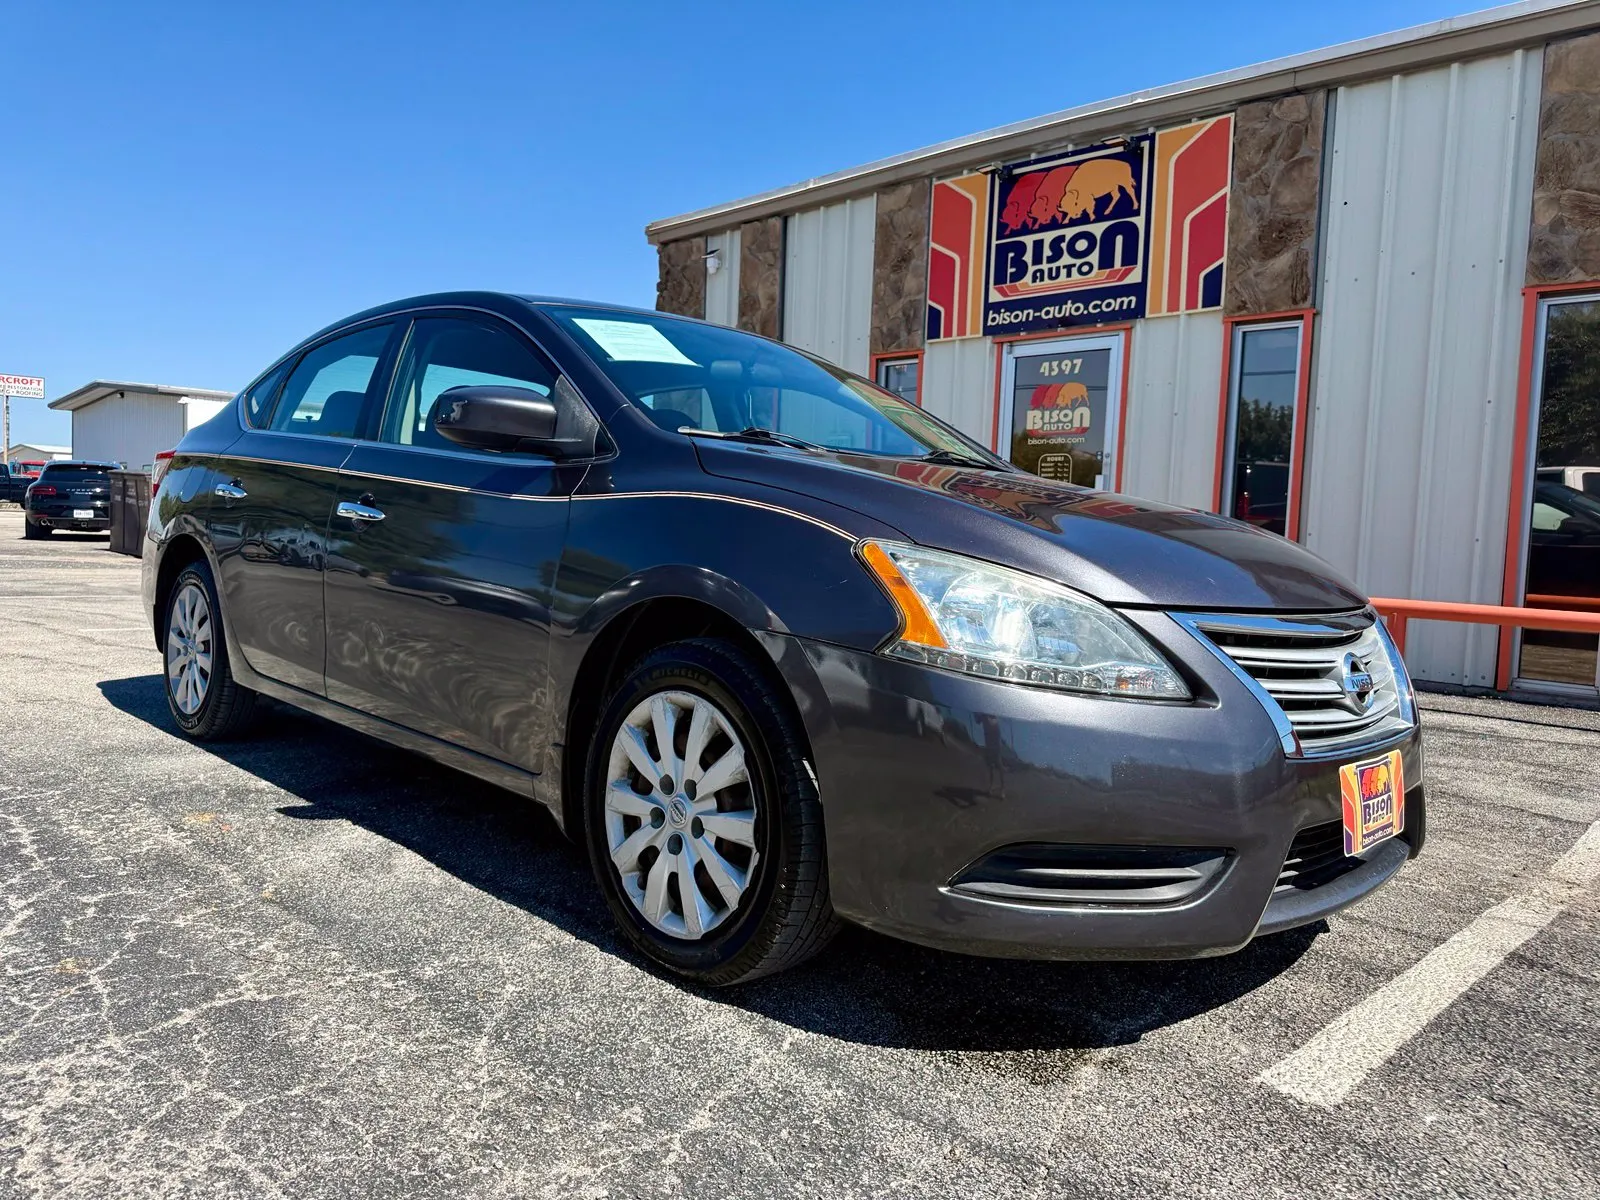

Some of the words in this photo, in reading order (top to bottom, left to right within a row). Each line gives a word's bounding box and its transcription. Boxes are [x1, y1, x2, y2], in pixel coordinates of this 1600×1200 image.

[994, 220, 1140, 286] BISON
[1032, 261, 1094, 284] AUTO
[987, 296, 1137, 327] bison-auto.com
[1039, 358, 1083, 377] 4397
[7, 384, 42, 392] RESTORATION
[1026, 406, 1091, 430] BISON
[1043, 422, 1072, 431] AUTO
[1027, 437, 1085, 445] bison-auto.com
[1351, 677, 1371, 689] NISS
[1363, 793, 1392, 826] BISON
[1372, 812, 1385, 825] AUTO
[1363, 826, 1393, 846] bison-auto.com
